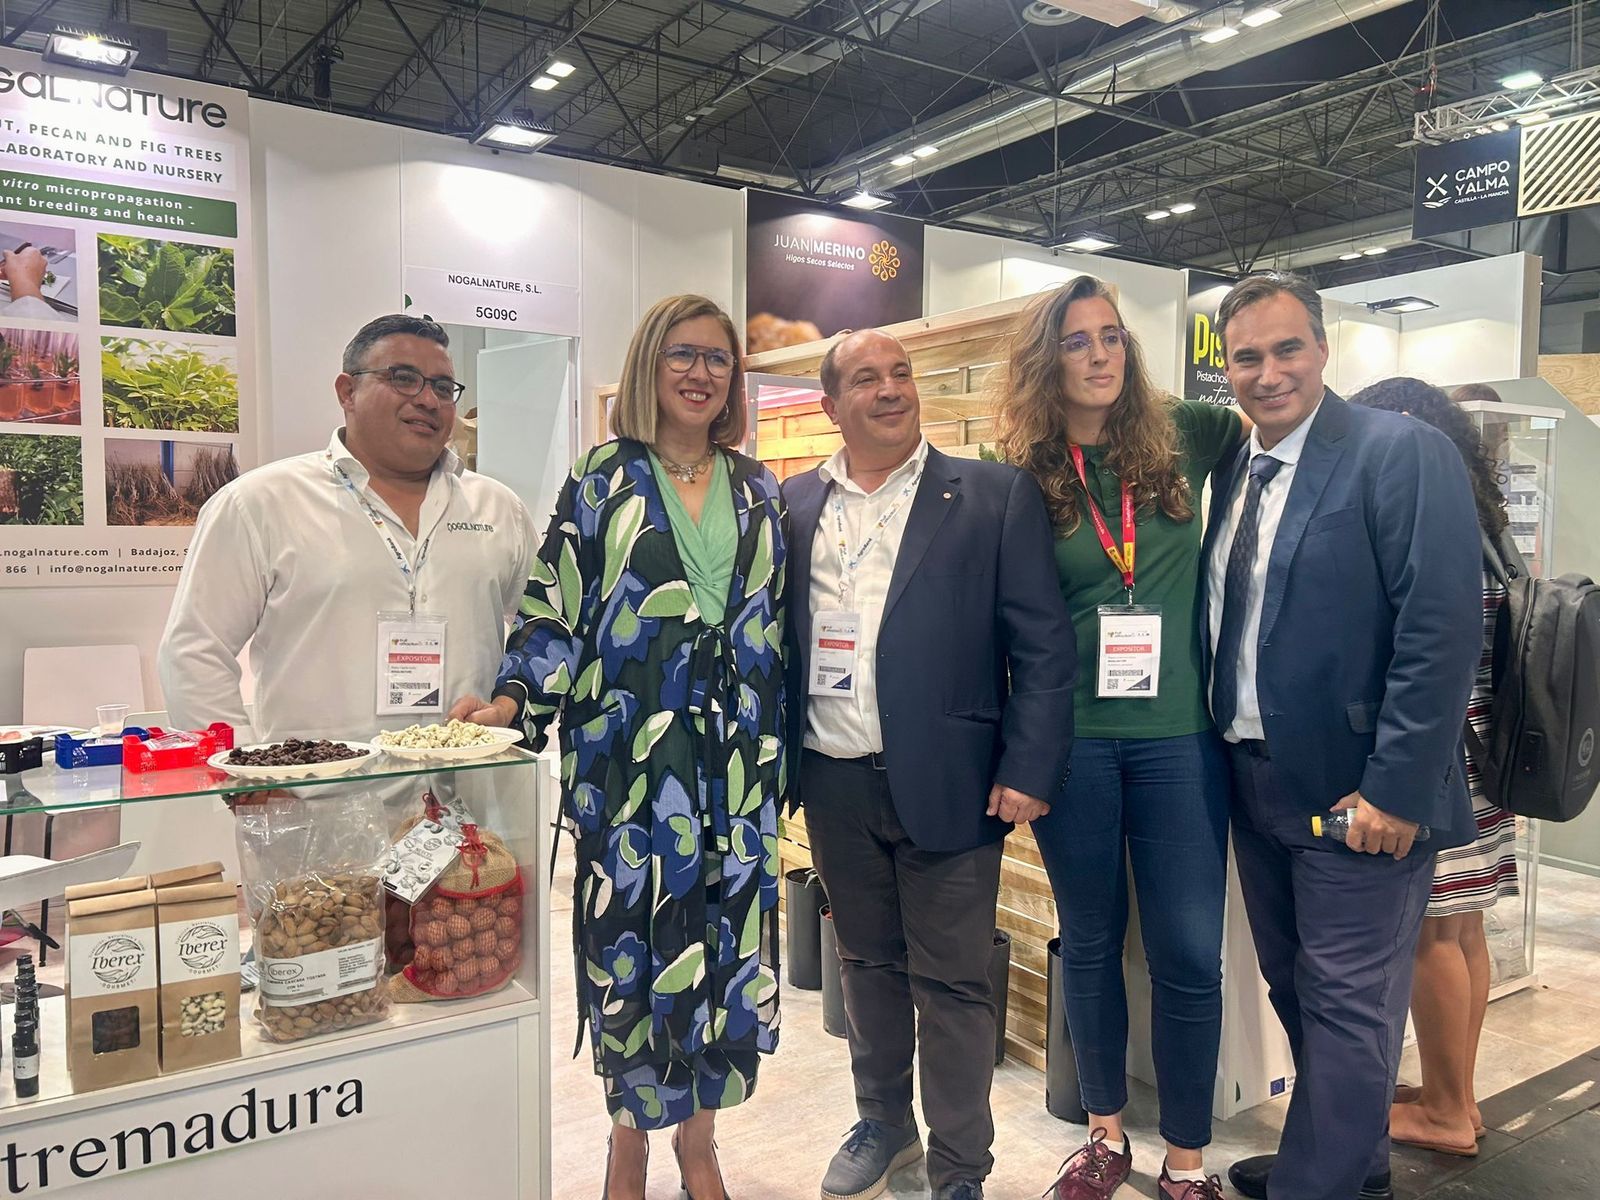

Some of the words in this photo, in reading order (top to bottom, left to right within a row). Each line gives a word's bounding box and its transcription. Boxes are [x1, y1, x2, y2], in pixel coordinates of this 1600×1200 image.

[29, 123, 87, 142] PECAN
[96, 133, 132, 148] AND
[141, 140, 167, 154] FIG
[174, 145, 222, 162] TREES
[113, 158, 147, 172] AND
[153, 164, 223, 183] NURSERY
[1455, 160, 1510, 182] CAMPO
[3, 178, 39, 190] vitro
[46, 183, 183, 210] micropropagation
[1455, 175, 1510, 196] YALMA
[1454, 196, 1477, 204] CASTILLA
[1488, 190, 1509, 198] MANCHA
[29, 196, 98, 217] breeding
[104, 207, 131, 219] and
[137, 210, 184, 226] health
[785, 254, 805, 264] Higos
[806, 257, 826, 267] Secos
[827, 260, 855, 271] Selectos
[448, 274, 524, 293] NOGALNATURE,
[525, 284, 542, 294] S.L.
[475, 306, 518, 322] 5G09C
[1196, 370, 1228, 384] Pistachos
[131, 548, 179, 558] Badajoz,
[5, 565, 27, 574] 866
[50, 564, 183, 575] info@nogalnature.com
[178, 938, 228, 957] Iberex
[92, 953, 145, 970] Iberex
[0, 1077, 364, 1195] tremadura
